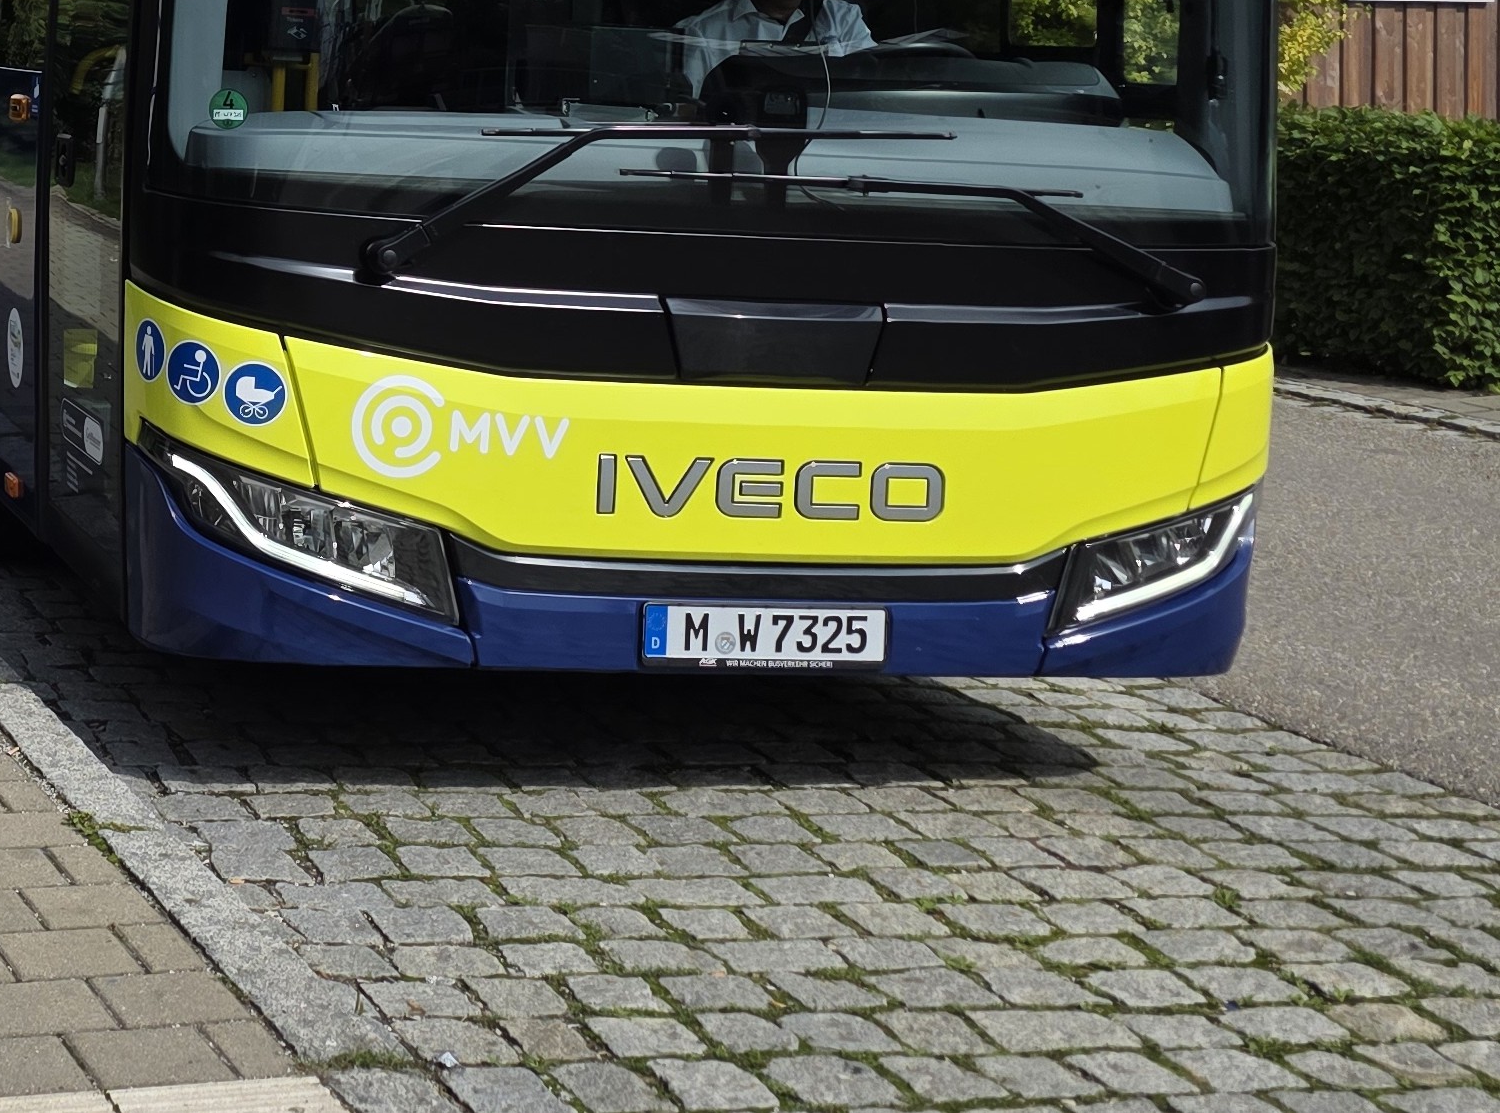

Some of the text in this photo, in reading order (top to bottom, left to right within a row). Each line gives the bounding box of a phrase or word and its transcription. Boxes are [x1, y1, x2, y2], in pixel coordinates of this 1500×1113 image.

[222, 90, 235, 110] 4
[449, 408, 570, 460] MVV
[595, 452, 946, 523] IVECO
[650, 636, 661, 650] D
[684, 612, 869, 654] M W 7325
